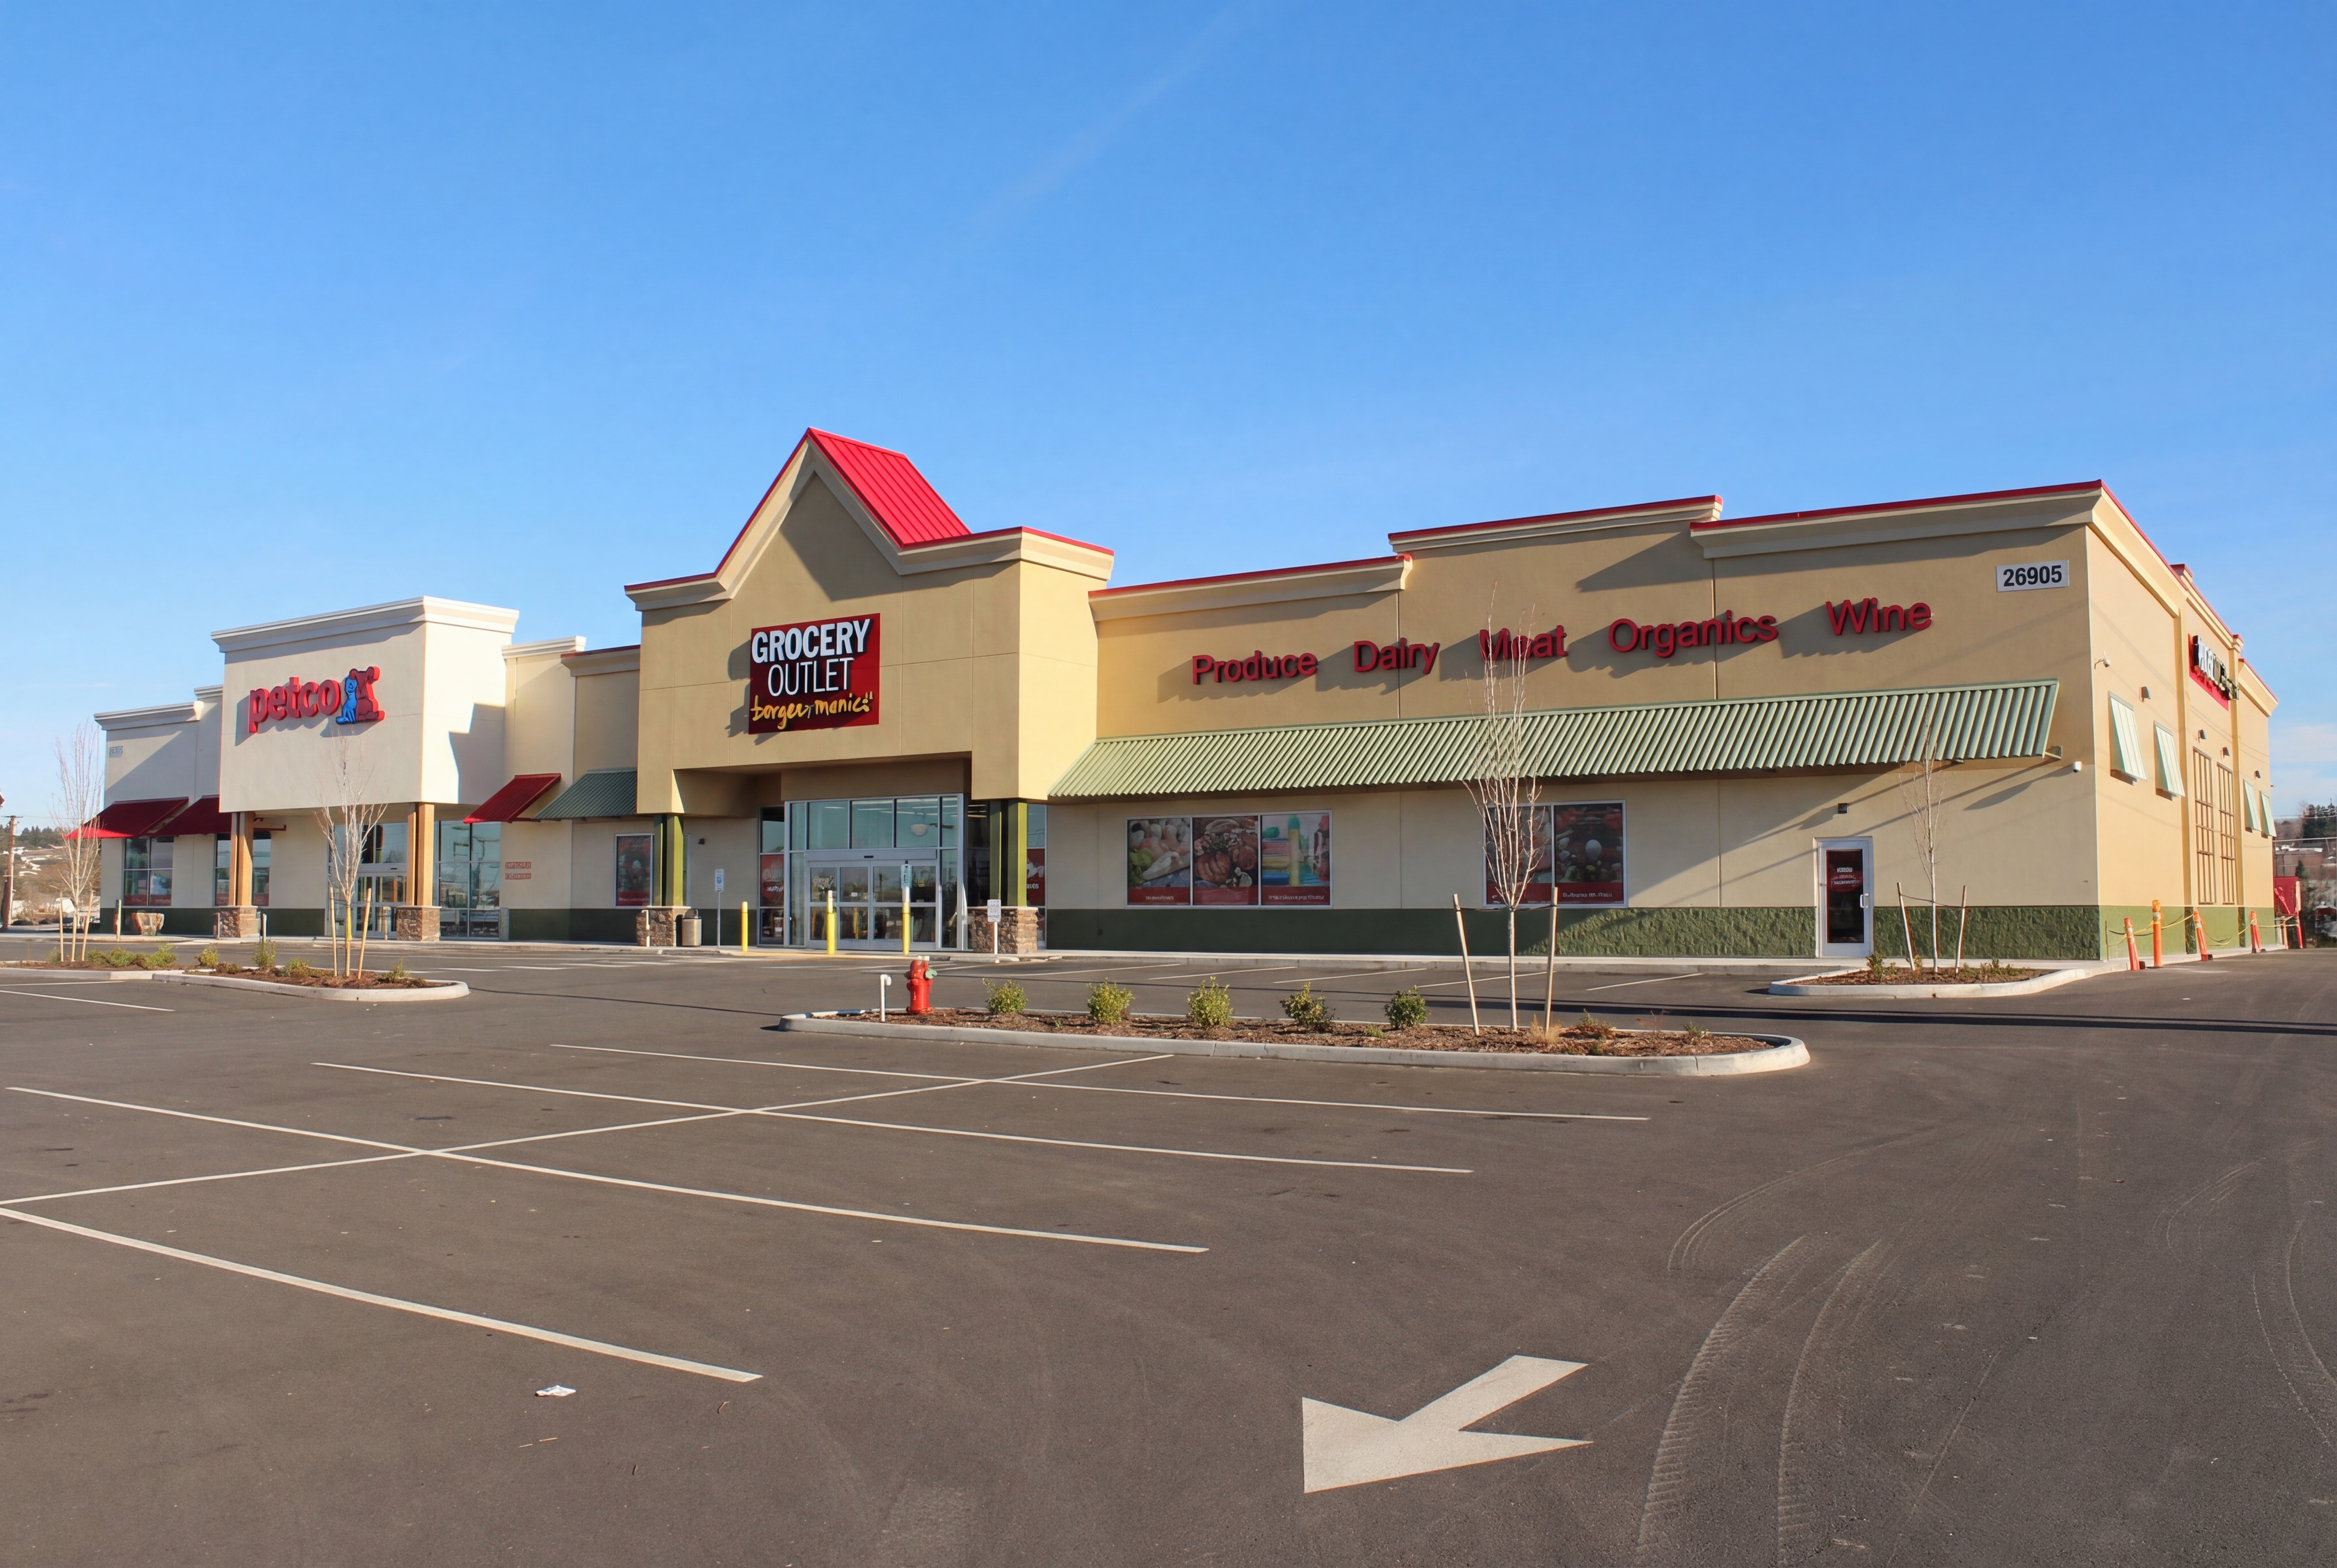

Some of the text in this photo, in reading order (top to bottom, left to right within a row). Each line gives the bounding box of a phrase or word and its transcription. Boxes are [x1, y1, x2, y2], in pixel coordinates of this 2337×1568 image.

[2003, 565, 2062, 587] 26905
[1609, 610, 1777, 657] Organics
[1825, 597, 1932, 636] Wine
[752, 619, 871, 663] GROCERY
[1354, 637, 1440, 674] Dairy
[768, 657, 855, 697] OUTLET
[1192, 650, 1318, 685] Produce
[248, 677, 341, 733] petco
